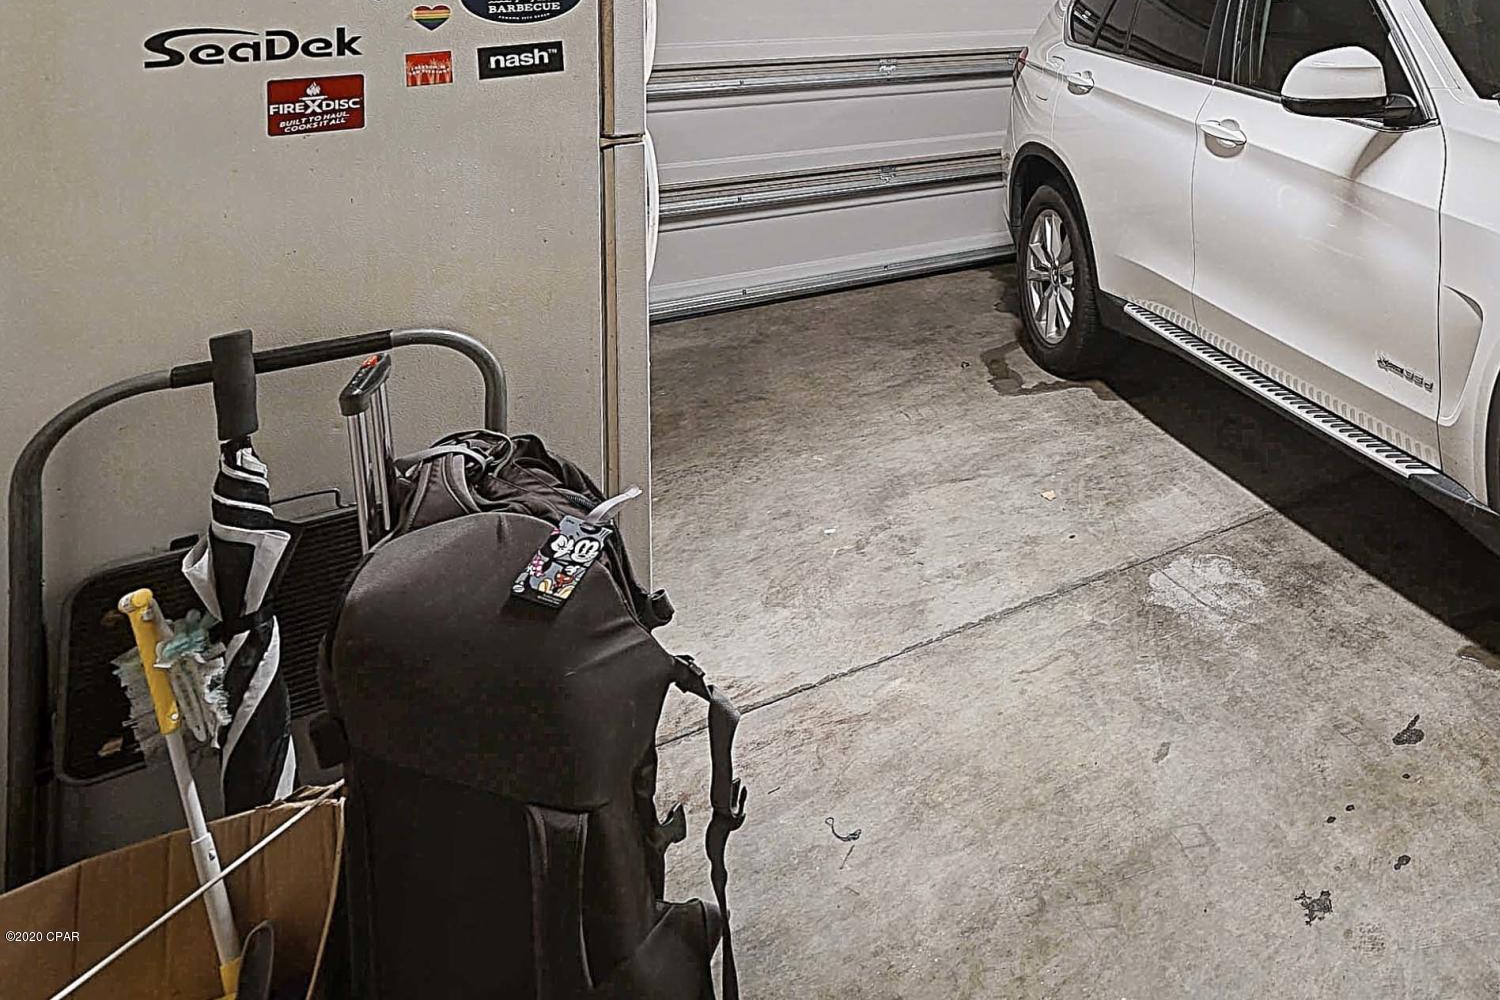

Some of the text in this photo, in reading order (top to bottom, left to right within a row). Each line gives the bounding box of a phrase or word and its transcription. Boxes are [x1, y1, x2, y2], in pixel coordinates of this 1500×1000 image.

[488, 2, 561, 14] BARBECUE
[143, 26, 363, 69] SeaDek
[279, 118, 308, 128] BUILT
[284, 122, 319, 133] COOKS
[329, 117, 347, 126] ALL
